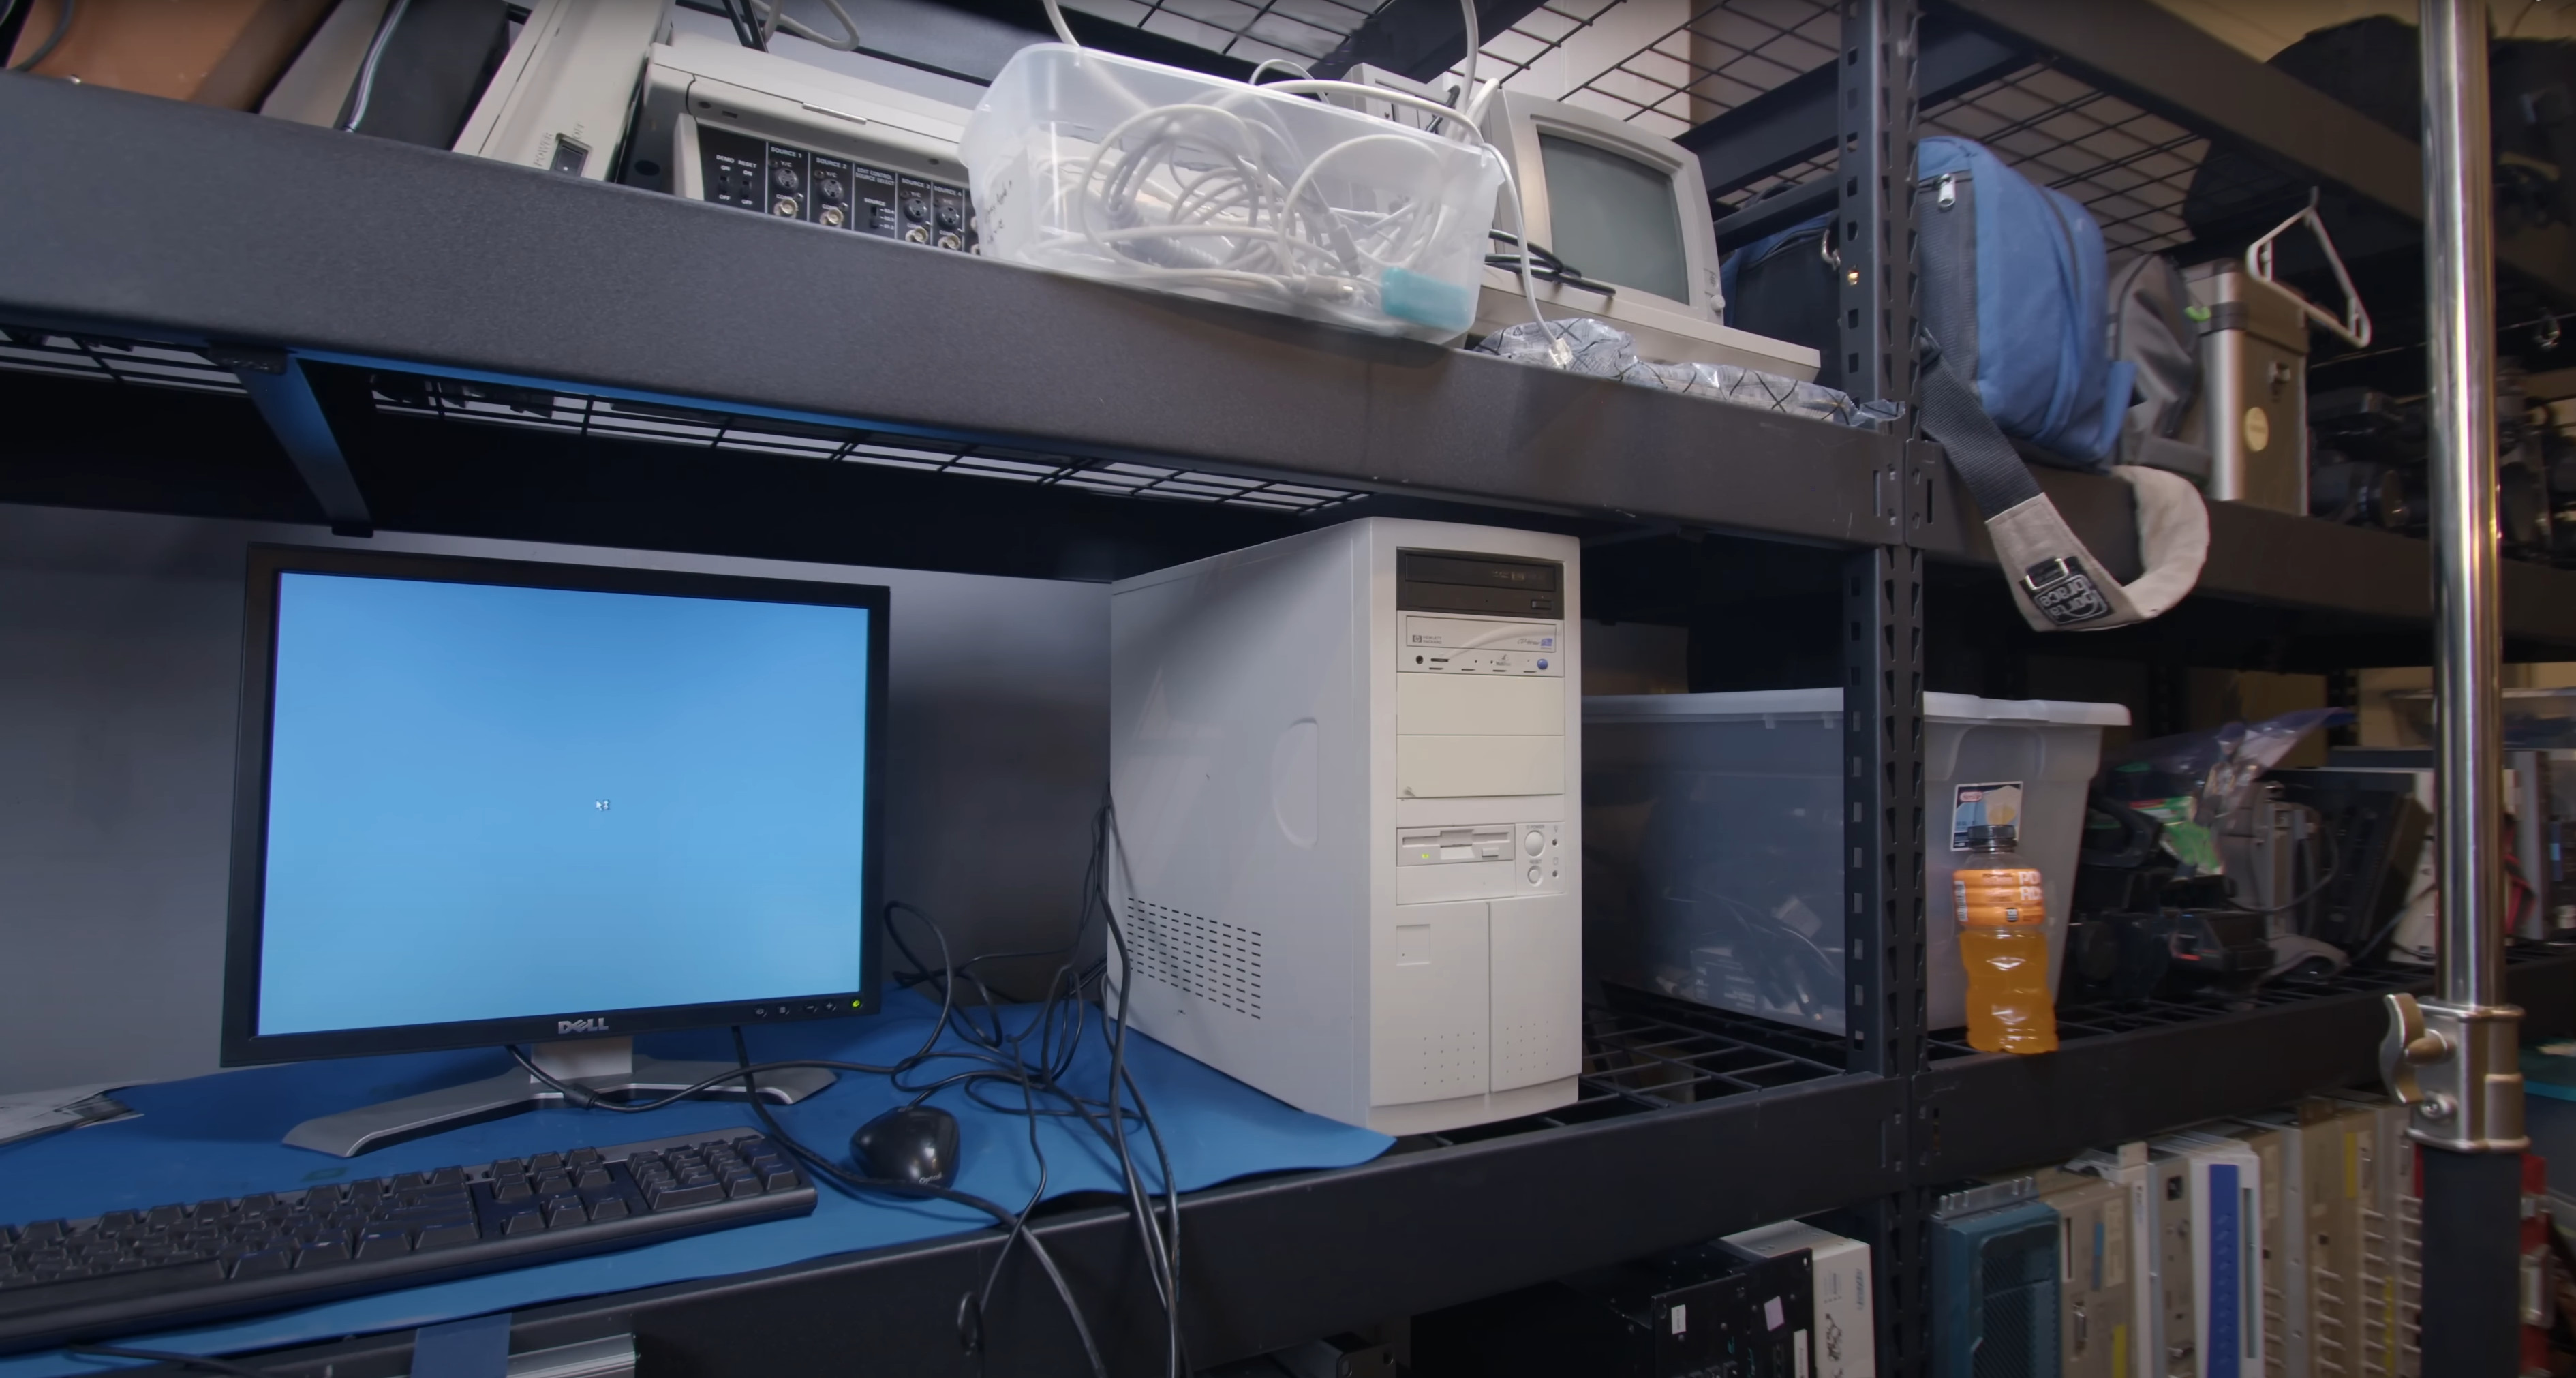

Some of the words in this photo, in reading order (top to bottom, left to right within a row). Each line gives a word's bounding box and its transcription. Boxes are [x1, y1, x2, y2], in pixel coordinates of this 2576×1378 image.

[771, 147, 797, 157] SOURCE
[716, 155, 735, 163] DEMO
[738, 159, 757, 168] RESET
[816, 157, 842, 168] SOURCE
[870, 170, 893, 180] CONTROL
[877, 177, 895, 186] SELECT
[902, 178, 925, 188] SOURCE
[934, 185, 956, 196] SOURCE
[2039, 577, 2091, 607] brace
[2050, 590, 2098, 617] porta
[558, 1017, 609, 1035] DELL
